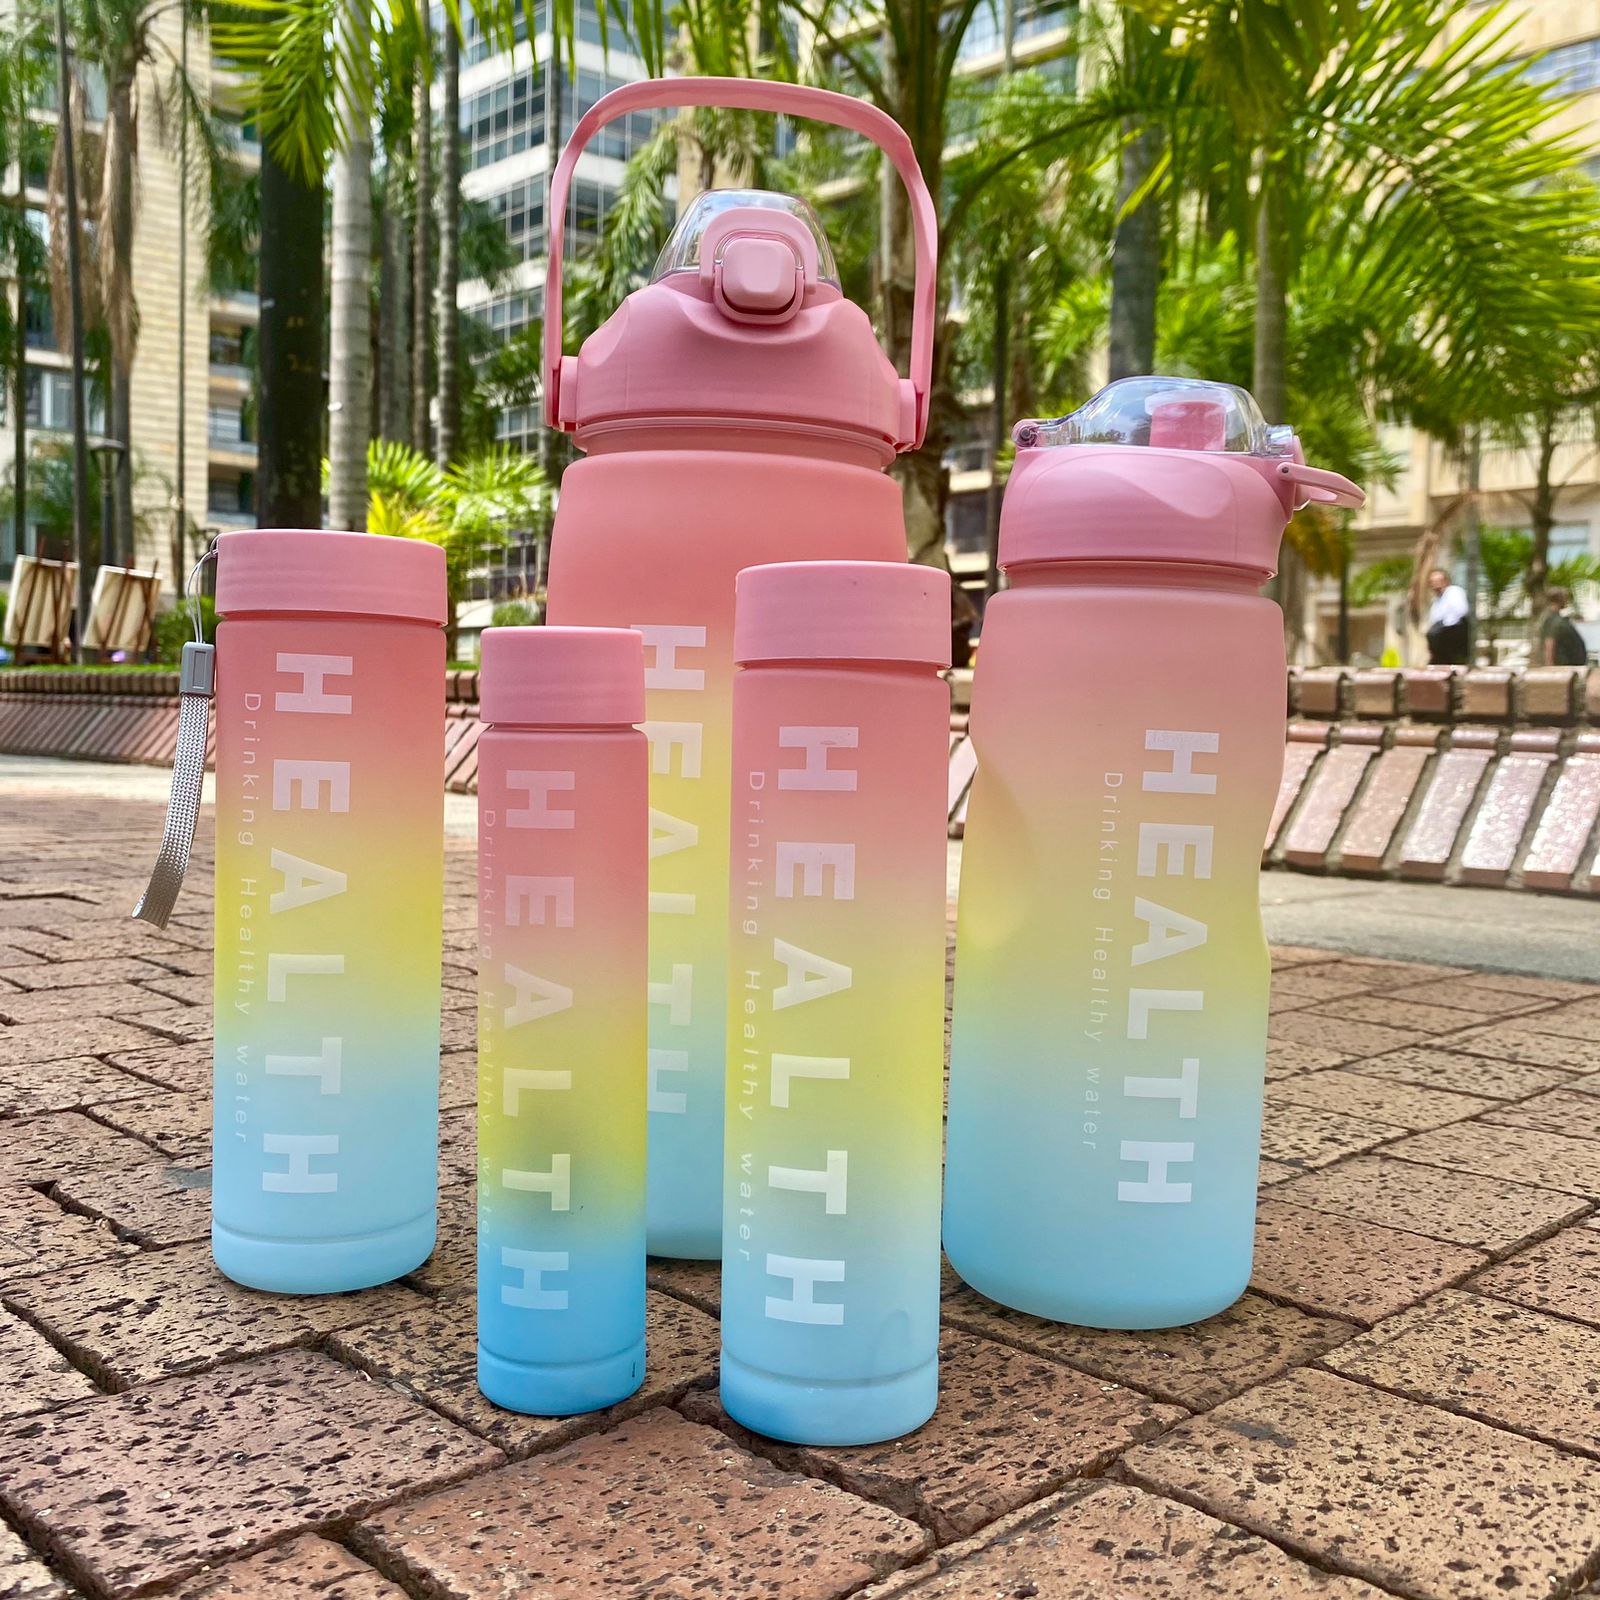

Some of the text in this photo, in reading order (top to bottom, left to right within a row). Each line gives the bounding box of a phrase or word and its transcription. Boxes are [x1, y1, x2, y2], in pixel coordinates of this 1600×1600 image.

[234, 692, 262, 1142] Drinking Healthy water
[262, 652, 353, 1194] HEALTH
[481, 810, 496, 960] Drinking
[501, 769, 575, 1310] HEALTH
[738, 771, 766, 1261] Drinking Healthy water
[765, 726, 859, 1326] HEALTH
[1082, 772, 1124, 1150] Drinking Healthy water
[1118, 729, 1220, 1203] HEALTH
